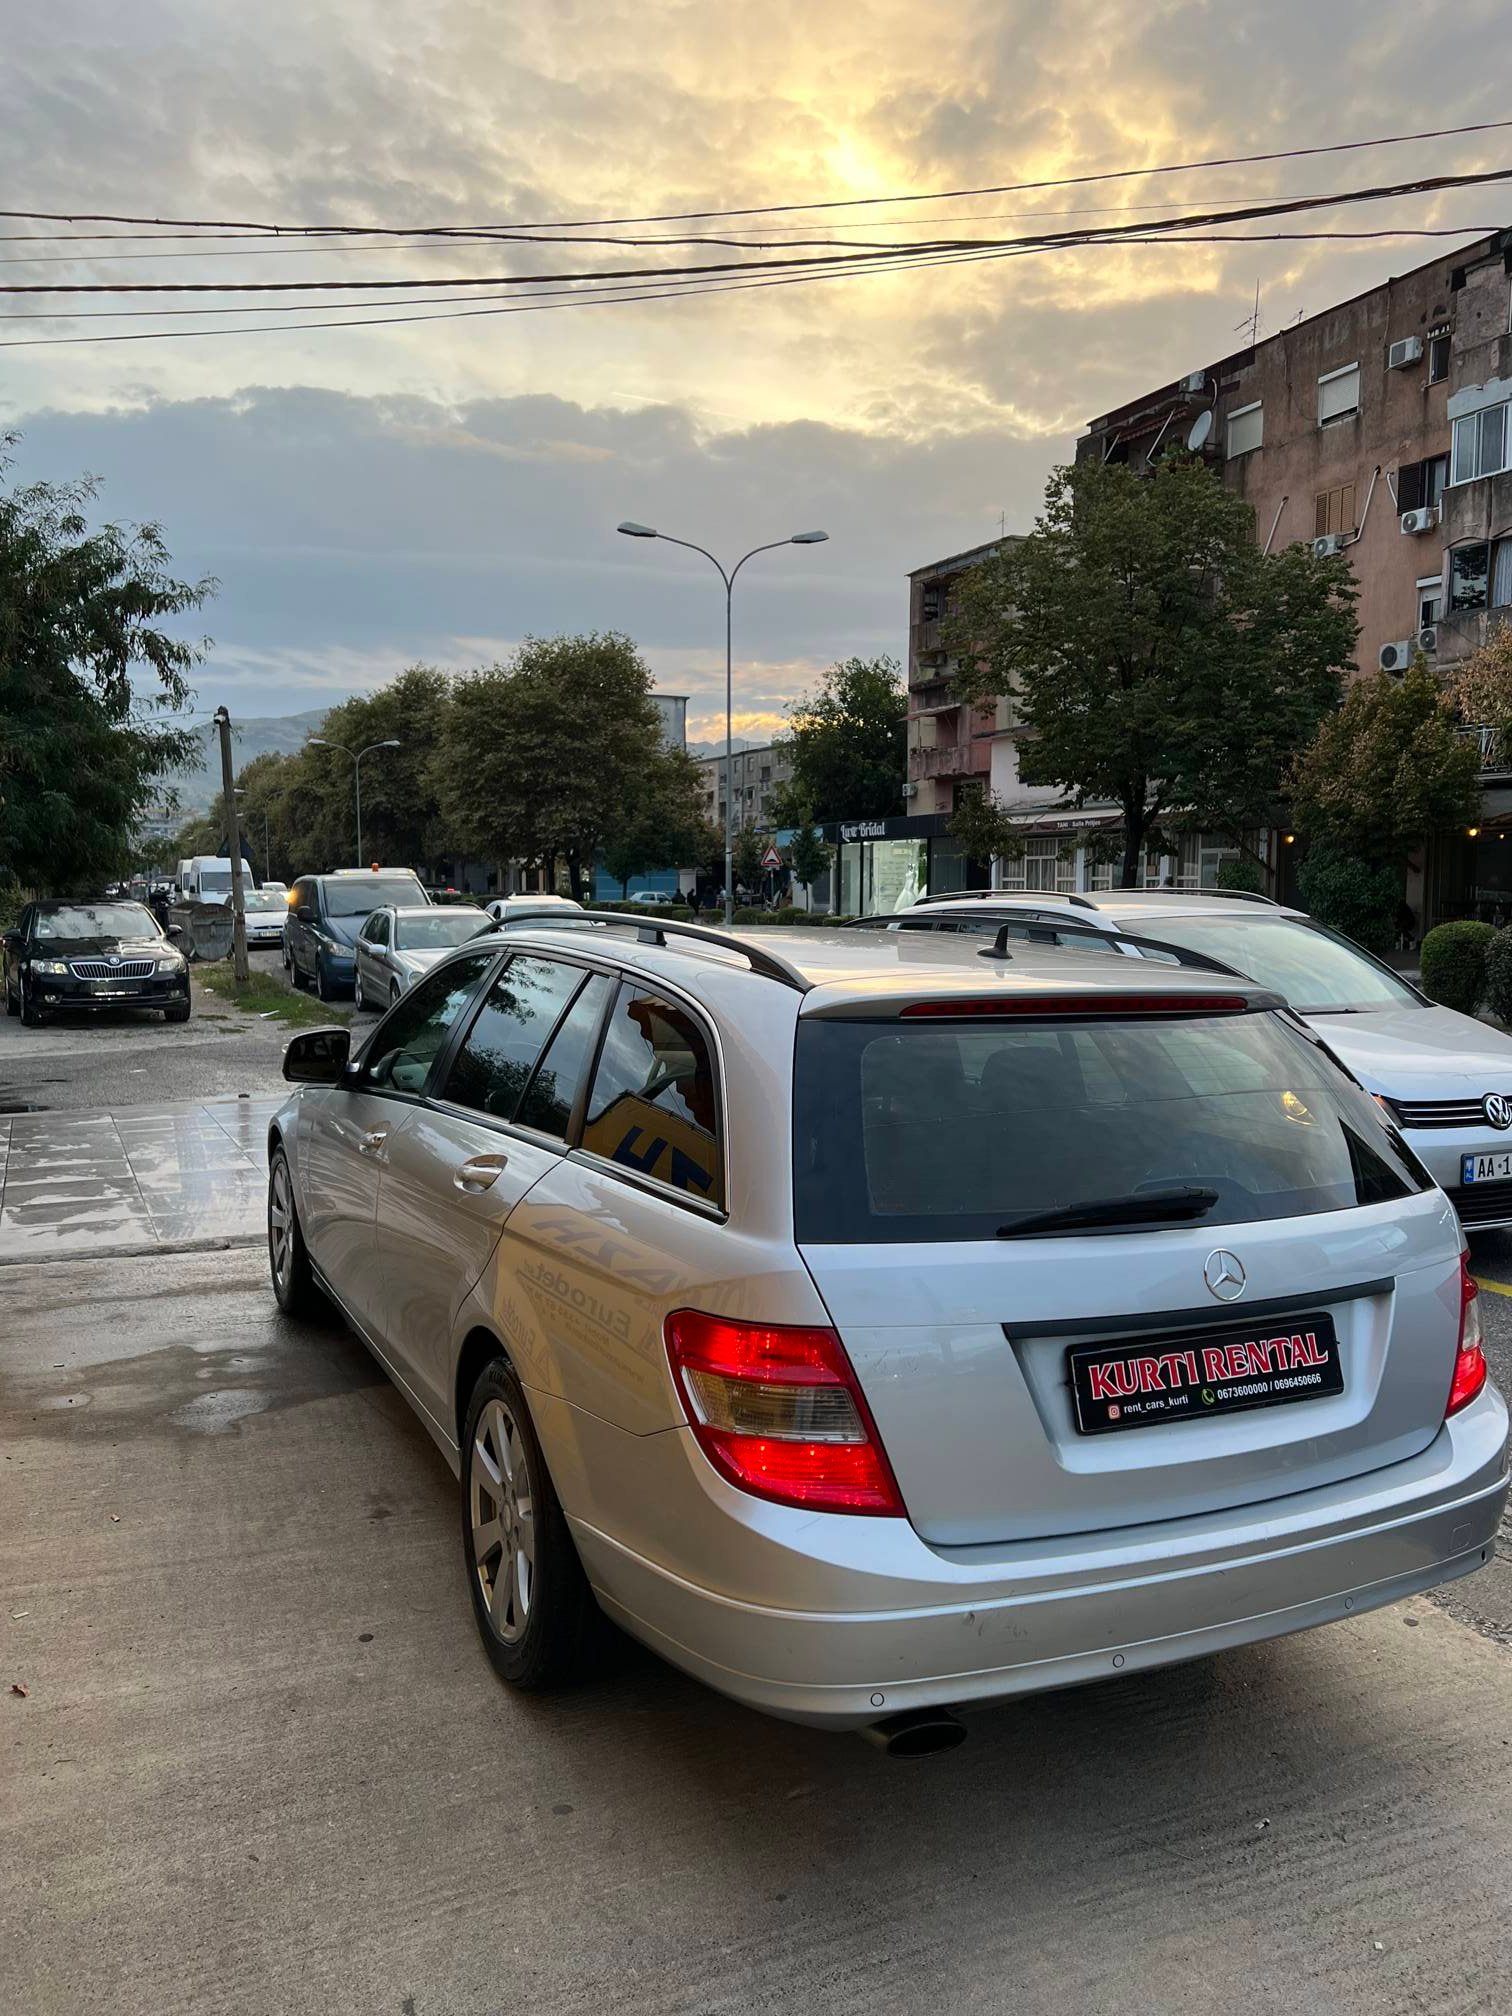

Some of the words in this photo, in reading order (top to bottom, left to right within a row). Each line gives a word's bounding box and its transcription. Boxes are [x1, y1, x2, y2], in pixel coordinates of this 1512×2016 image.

[859, 821, 886, 837] Bridal
[1088, 1350, 1200, 1400] KURTI
[1202, 1333, 1329, 1382] RENTAL
[1217, 1381, 1268, 1399] 0673600000
[1274, 1373, 1322, 1390] 0696450666
[1123, 1394, 1189, 1413] rent_cars_kurti
